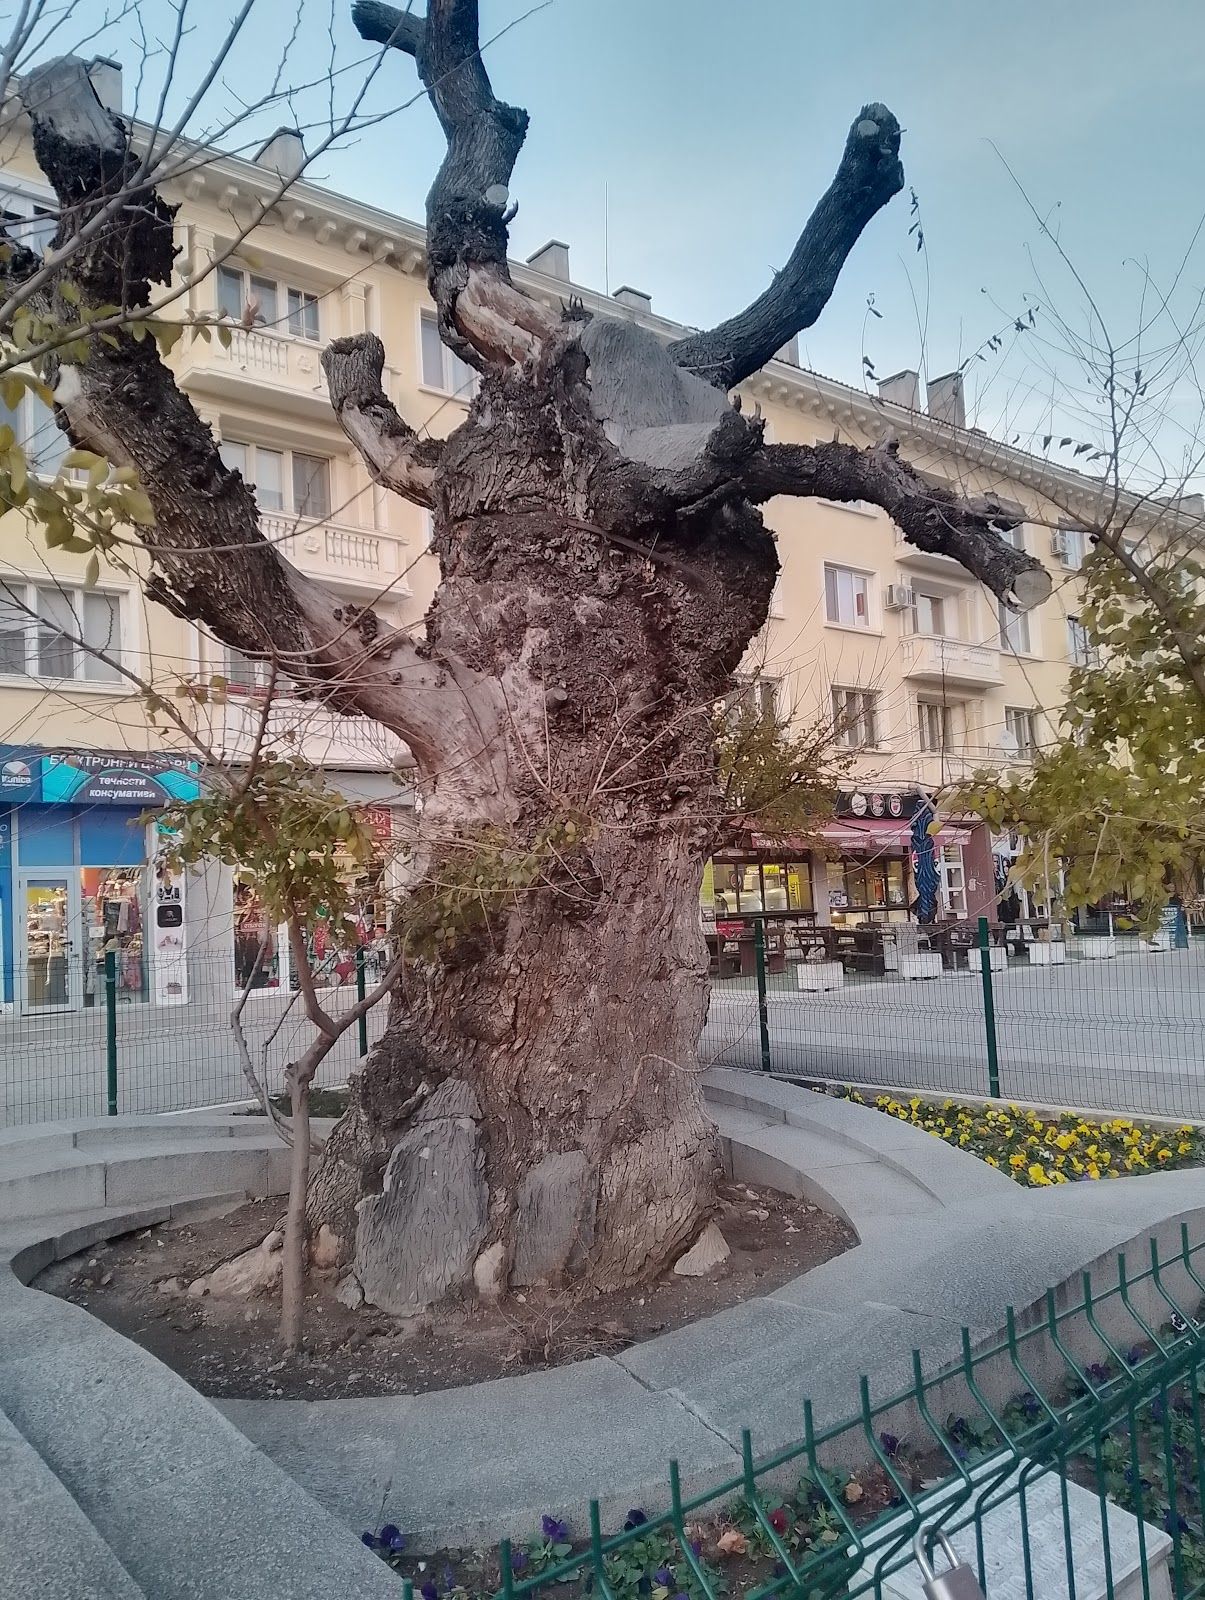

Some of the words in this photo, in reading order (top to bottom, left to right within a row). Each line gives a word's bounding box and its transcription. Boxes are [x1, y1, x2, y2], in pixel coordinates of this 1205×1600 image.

[49, 754, 138, 769] ЕЛКТРОННИ
[99, 777, 146, 786] точности
[89, 789, 156, 799] консумативи
